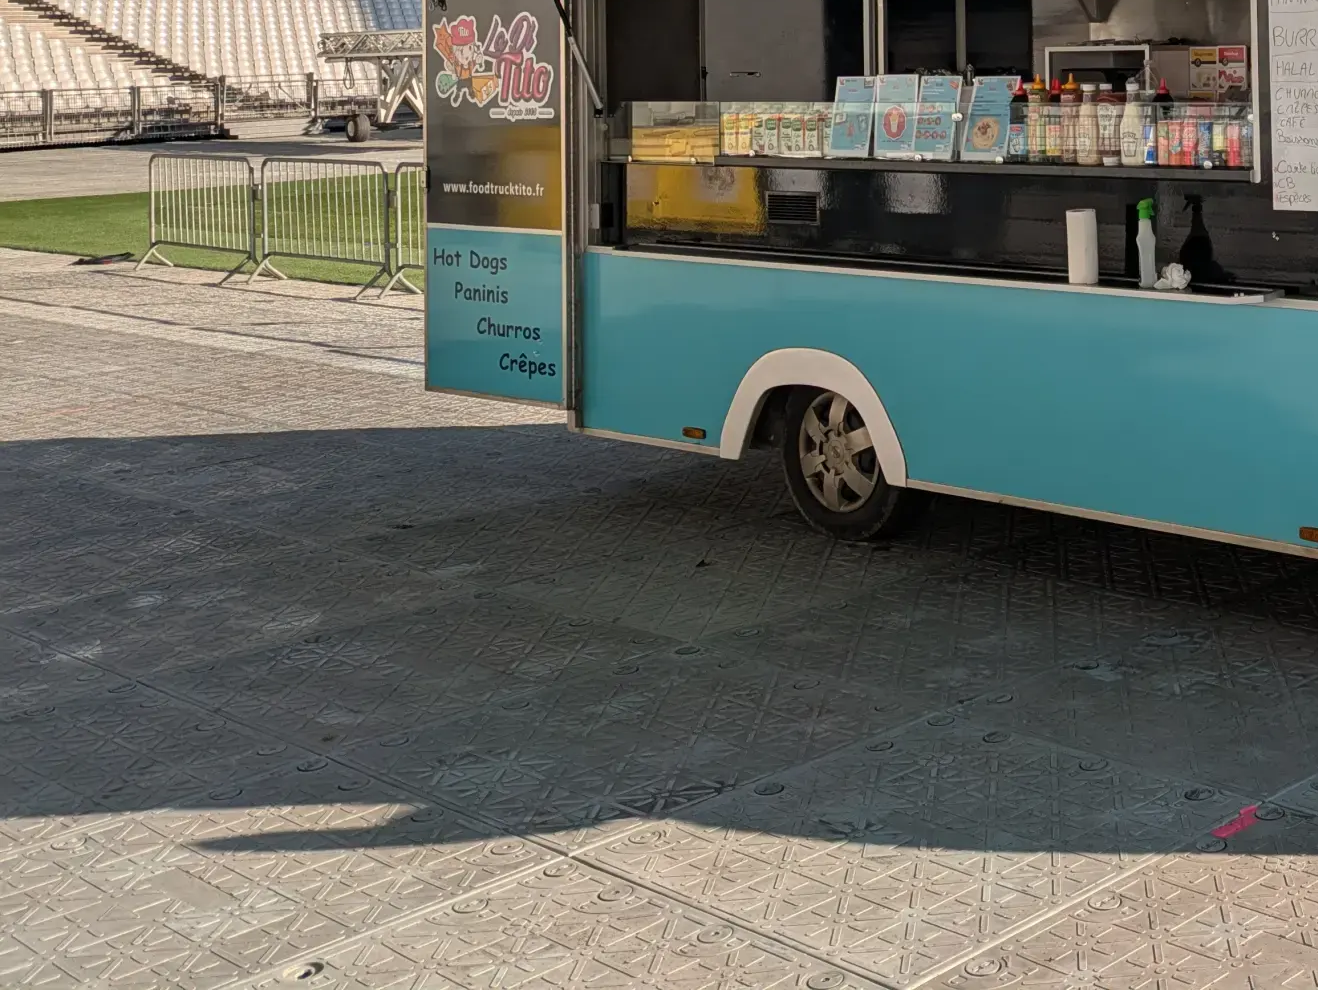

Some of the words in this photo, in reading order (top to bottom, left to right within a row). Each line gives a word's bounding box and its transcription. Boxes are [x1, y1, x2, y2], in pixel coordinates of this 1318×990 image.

[495, 51, 549, 102] Tito
[1276, 61, 1315, 76] HALAL
[1277, 160, 1307, 174] Carte
[443, 180, 545, 197] www.foodtrucktito.fr
[433, 248, 462, 267] Hot
[470, 250, 507, 275] Dogs
[454, 282, 508, 304] Paninis
[477, 317, 541, 341] Churros
[499, 353, 556, 379] Crêpes
